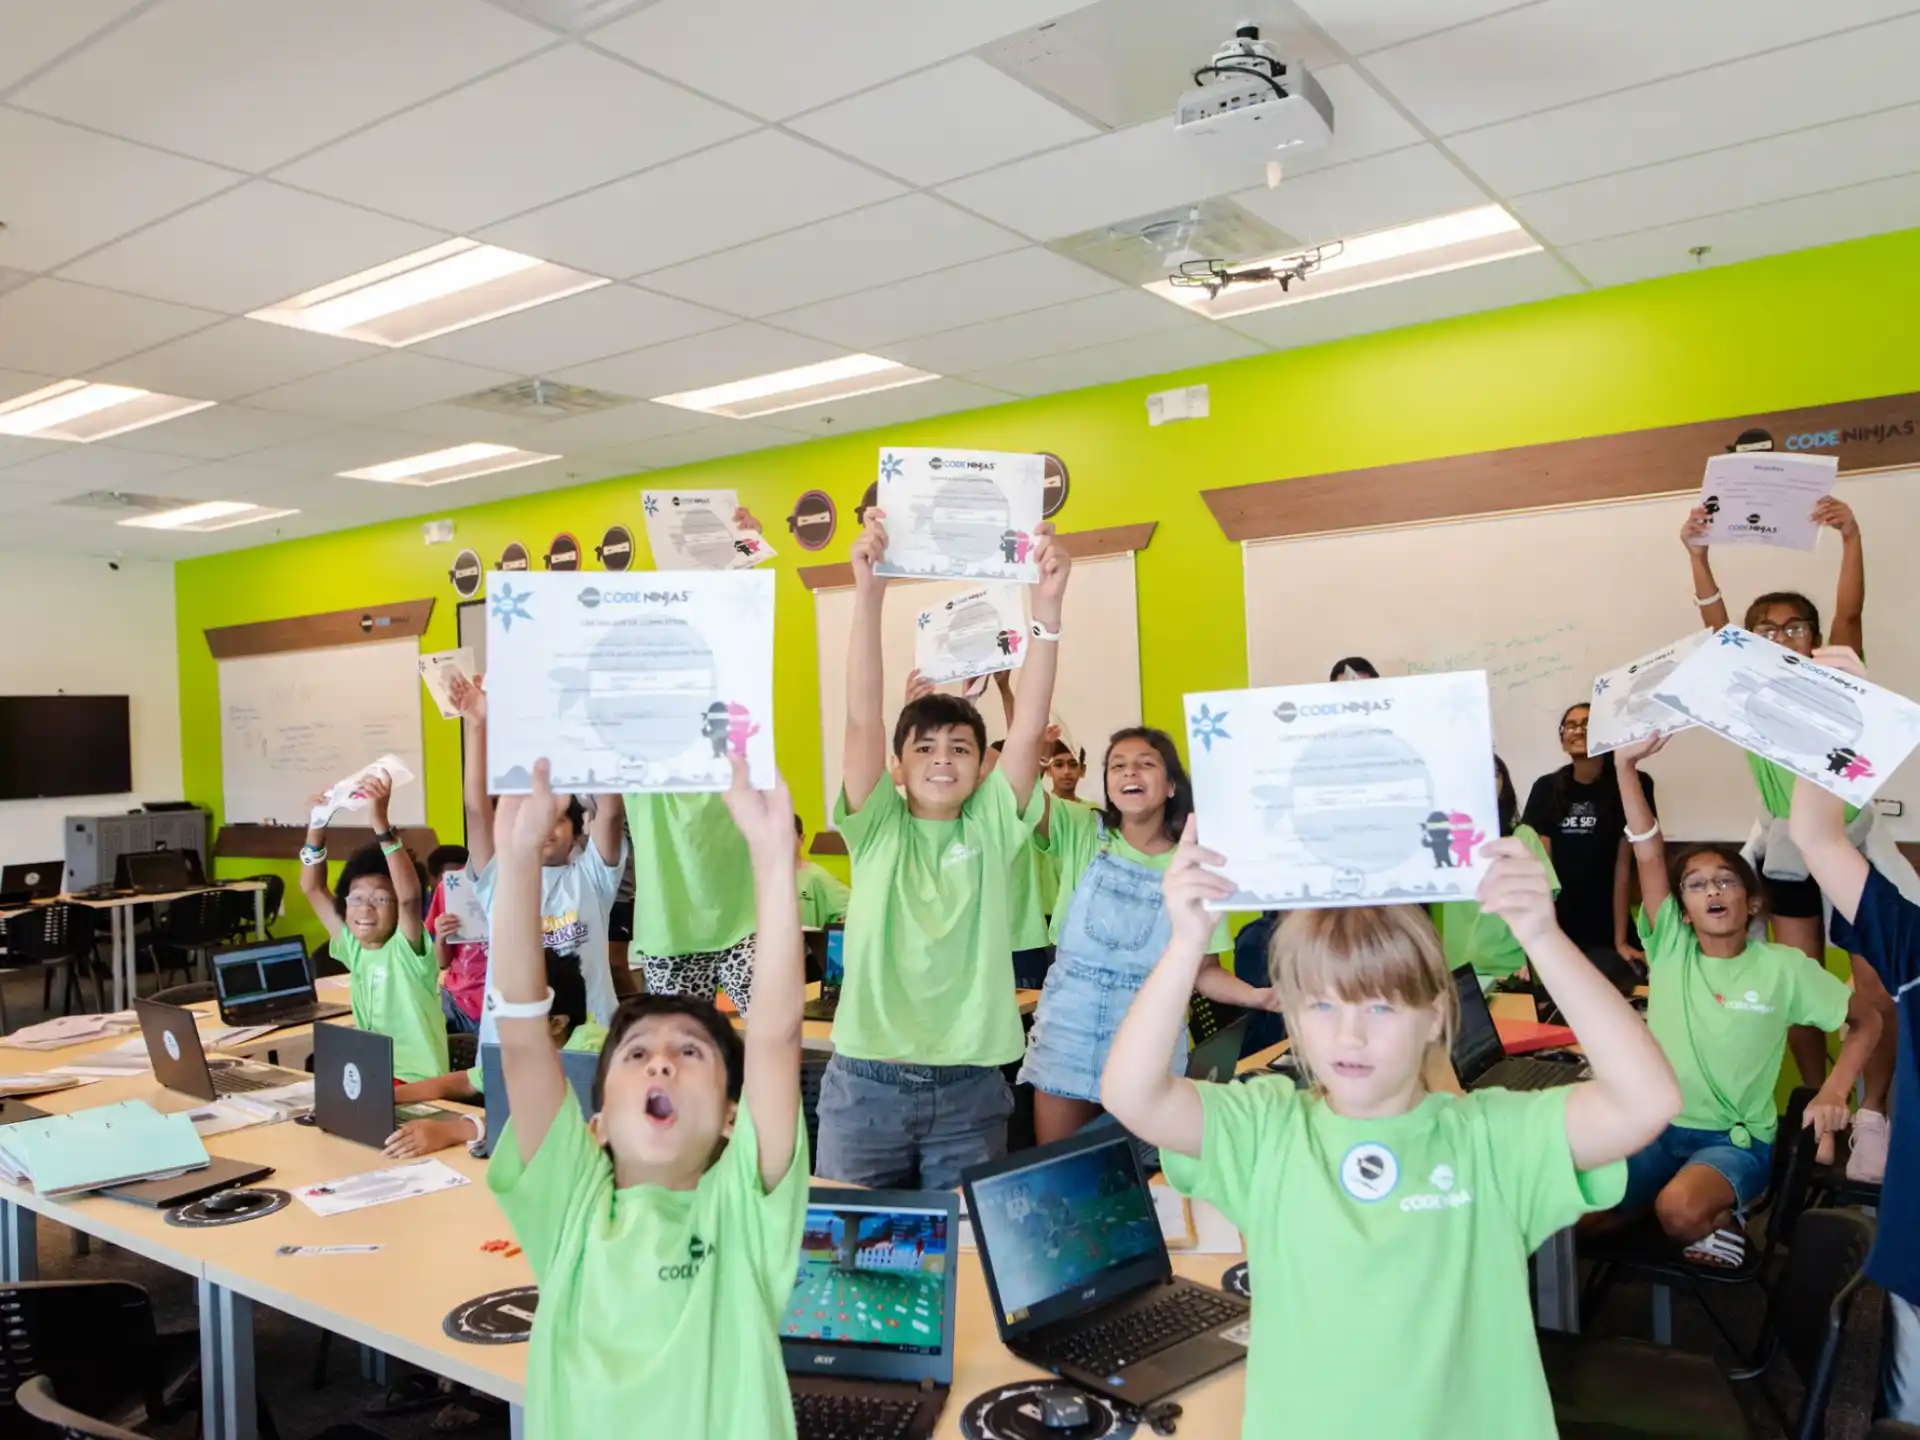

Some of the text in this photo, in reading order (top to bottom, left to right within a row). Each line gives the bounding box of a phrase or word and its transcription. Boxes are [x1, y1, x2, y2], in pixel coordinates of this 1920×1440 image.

[1785, 420, 1915, 450] CODE NINJAS
[943, 460, 995, 471] CODE NINJAS
[1749, 525, 1778, 534] NINJAS
[602, 590, 689, 607] CODE NINJAS
[1800, 662, 1868, 694] CODE NINJAS
[1300, 698, 1392, 717] CODE NINJAS
